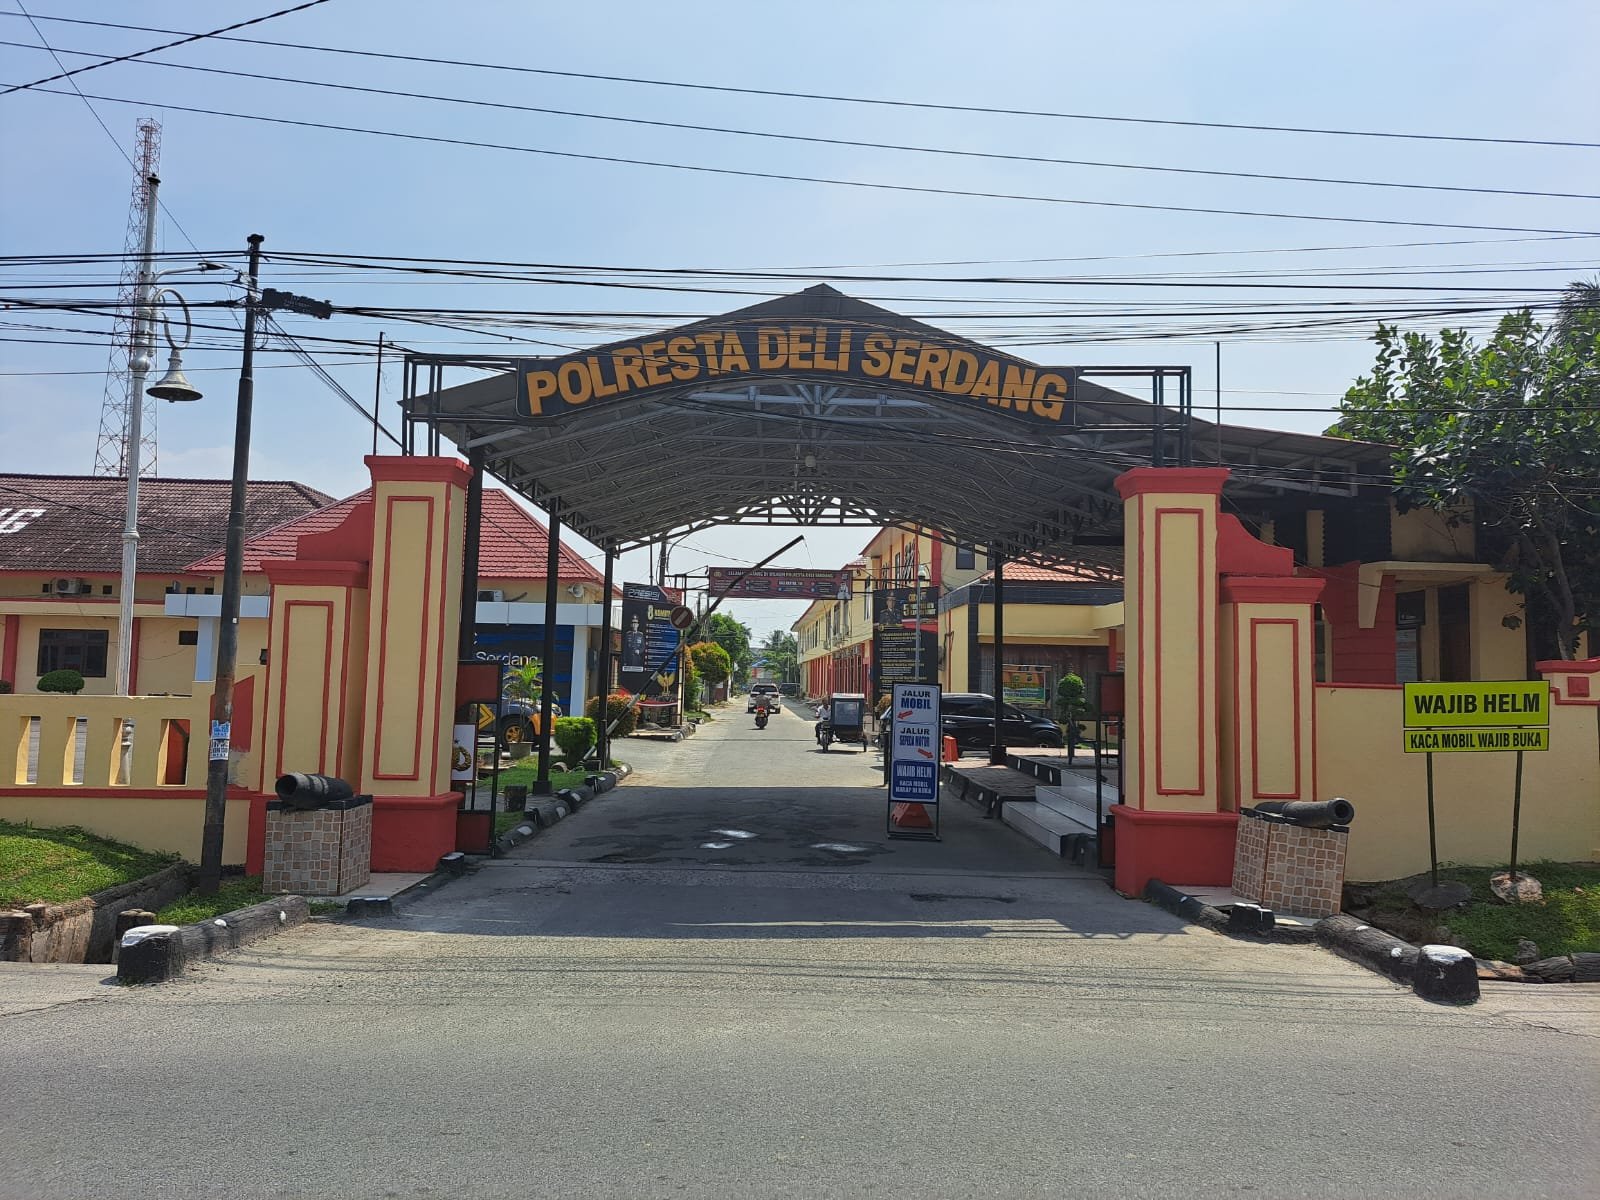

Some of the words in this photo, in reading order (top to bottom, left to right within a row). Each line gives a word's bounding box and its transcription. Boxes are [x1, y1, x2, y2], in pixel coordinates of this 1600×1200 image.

[526, 329, 750, 416] POLRESTA
[758, 325, 852, 371] DELI
[861, 331, 1067, 421] SERDANG
[647, 605, 654, 620] 8
[901, 690, 931, 698] JALUR
[901, 698, 932, 710] MOBIL
[1414, 694, 1477, 714] WAJIB
[1483, 693, 1540, 713] HELM
[900, 727, 930, 735] JALUR
[1410, 733, 1439, 748] KACA
[1441, 733, 1475, 748] MOBIL
[1478, 733, 1510, 747] WAJIB
[1513, 732, 1541, 747] BUKA
[896, 764, 916, 777] WAJIB
[916, 766, 932, 778] HELM
